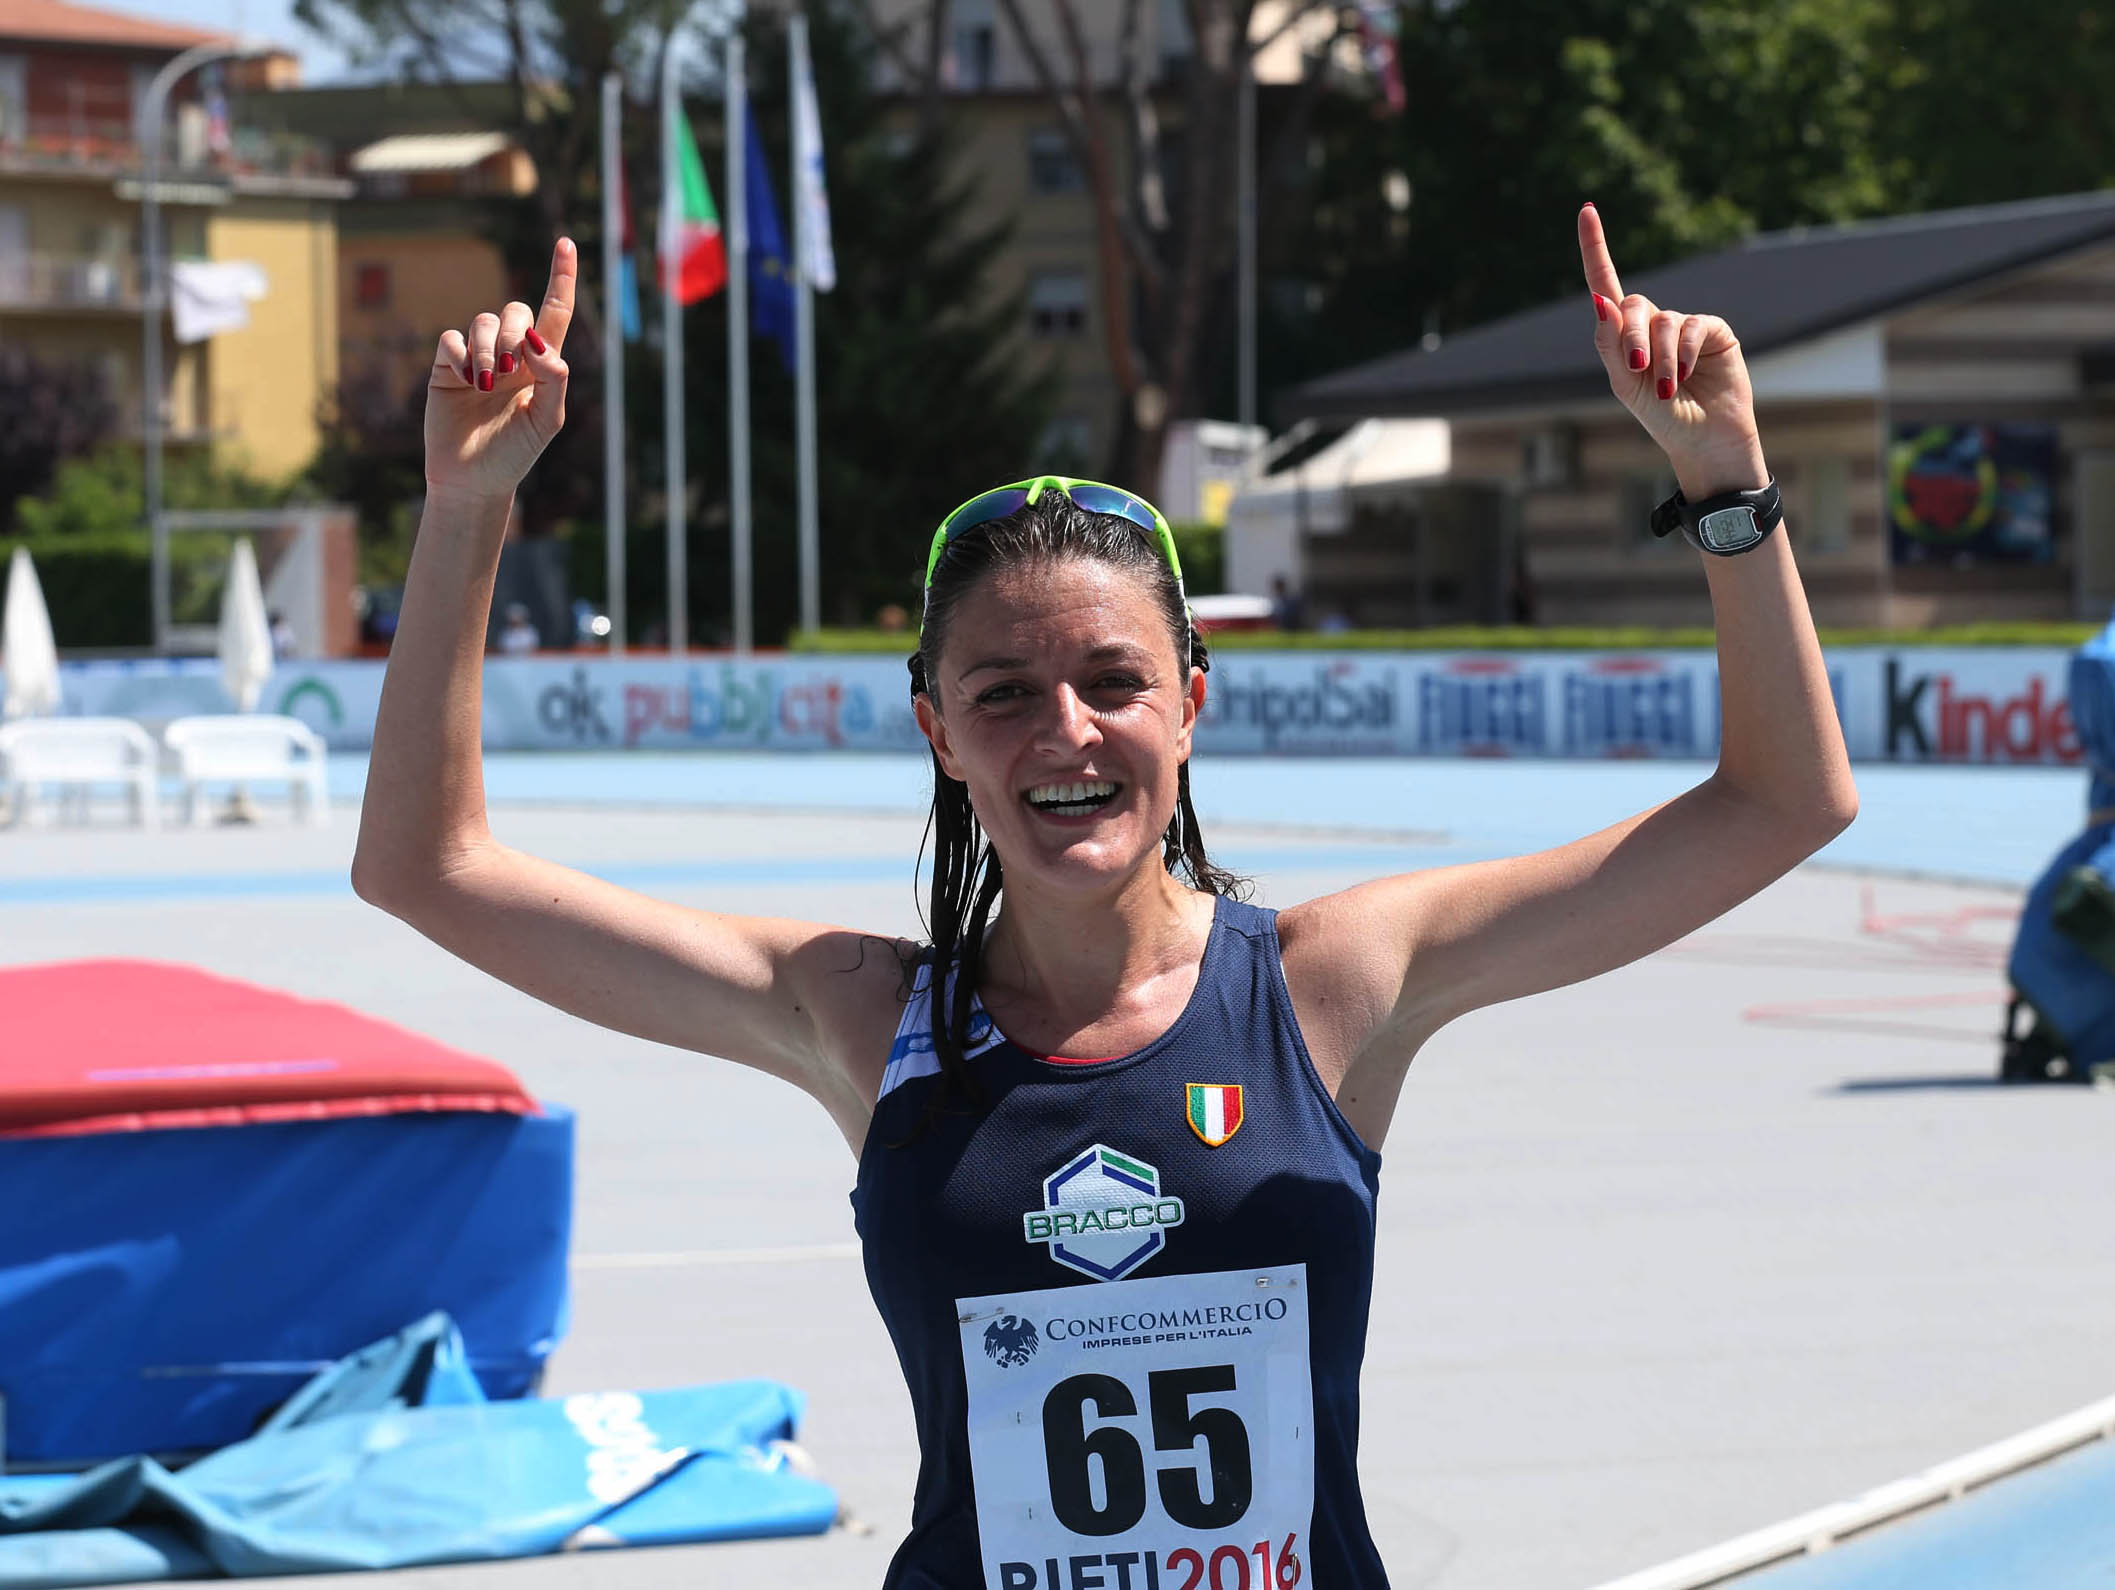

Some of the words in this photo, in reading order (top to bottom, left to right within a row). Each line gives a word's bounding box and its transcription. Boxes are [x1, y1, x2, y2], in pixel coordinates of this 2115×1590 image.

[1028, 1201, 1181, 1239] BRACCO
[1045, 1297, 1288, 1341] CONFCOMMERCIO
[1082, 1335, 1152, 1349] IMPRESE
[1155, 1331, 1186, 1343] PER
[1189, 1326, 1253, 1340] L'ITALIA
[1042, 1364, 1253, 1537] 65
